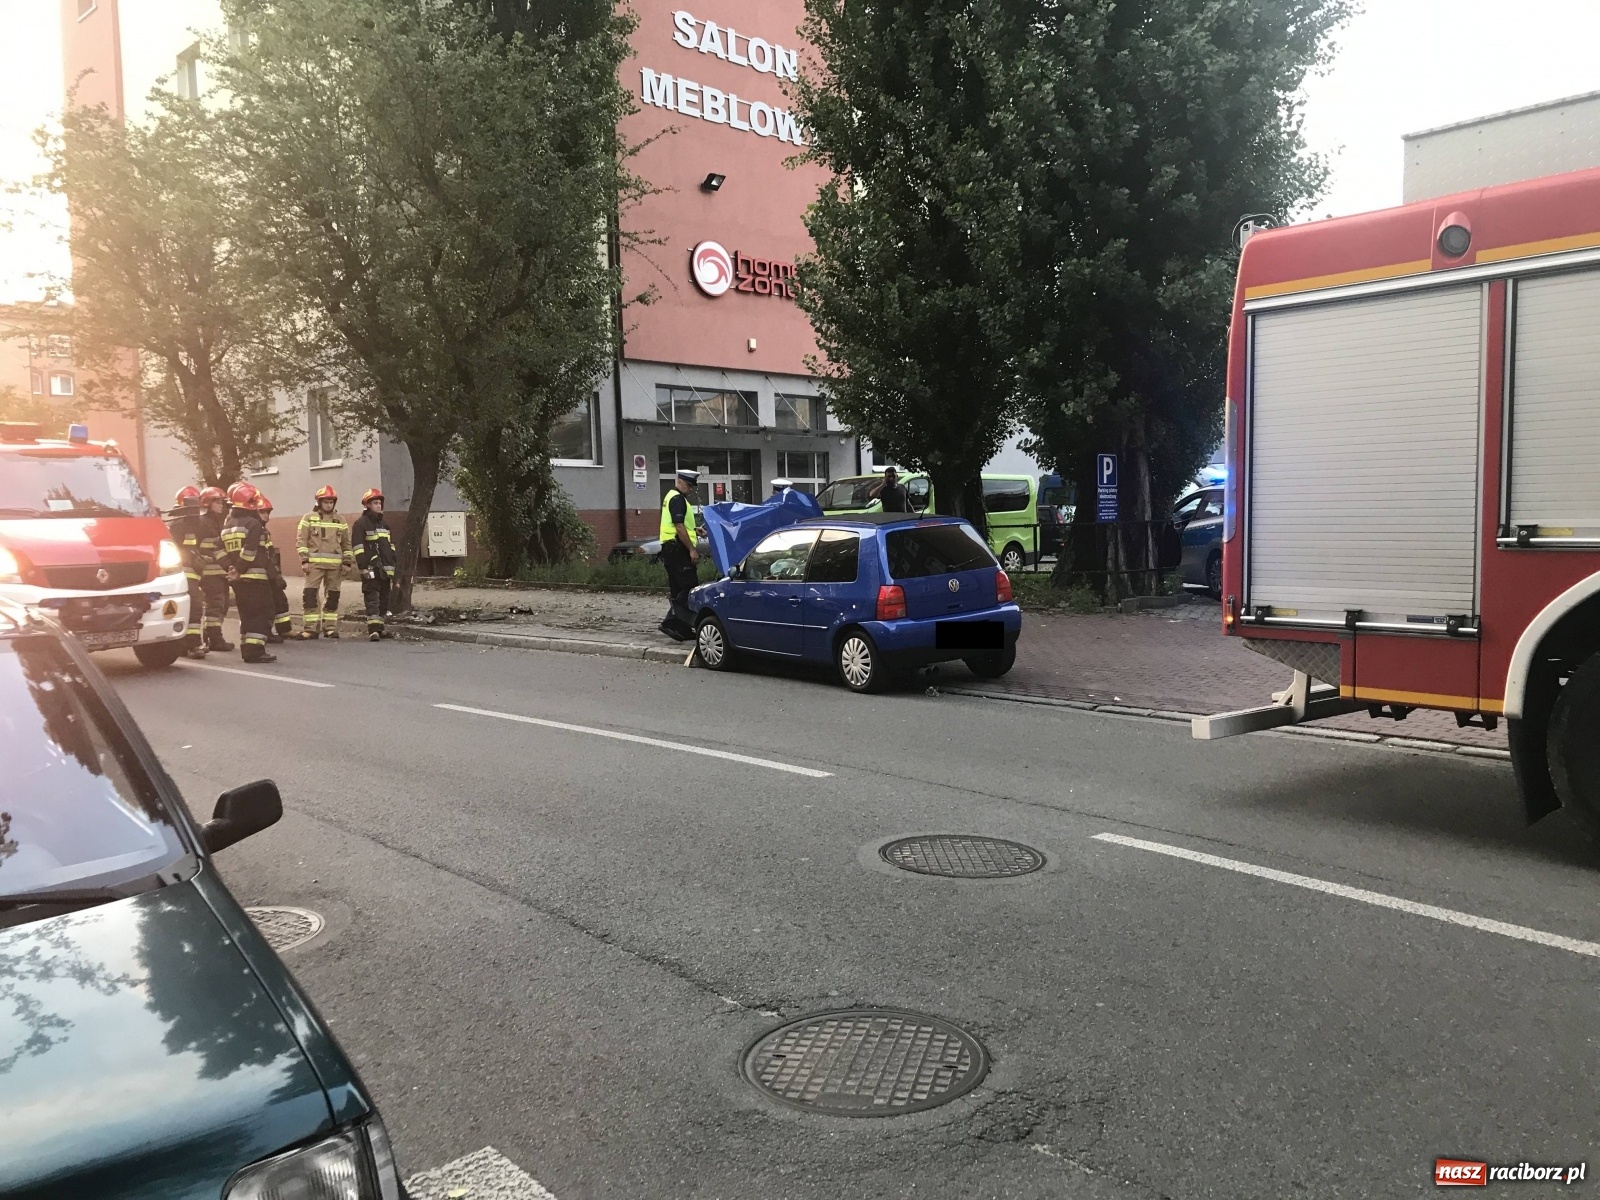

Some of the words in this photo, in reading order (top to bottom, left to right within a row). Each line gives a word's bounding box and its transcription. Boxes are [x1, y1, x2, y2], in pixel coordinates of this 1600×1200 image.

[672, 10, 798, 82] SALON
[641, 66, 816, 146] MEBLOW
[1103, 457, 1113, 484] P
